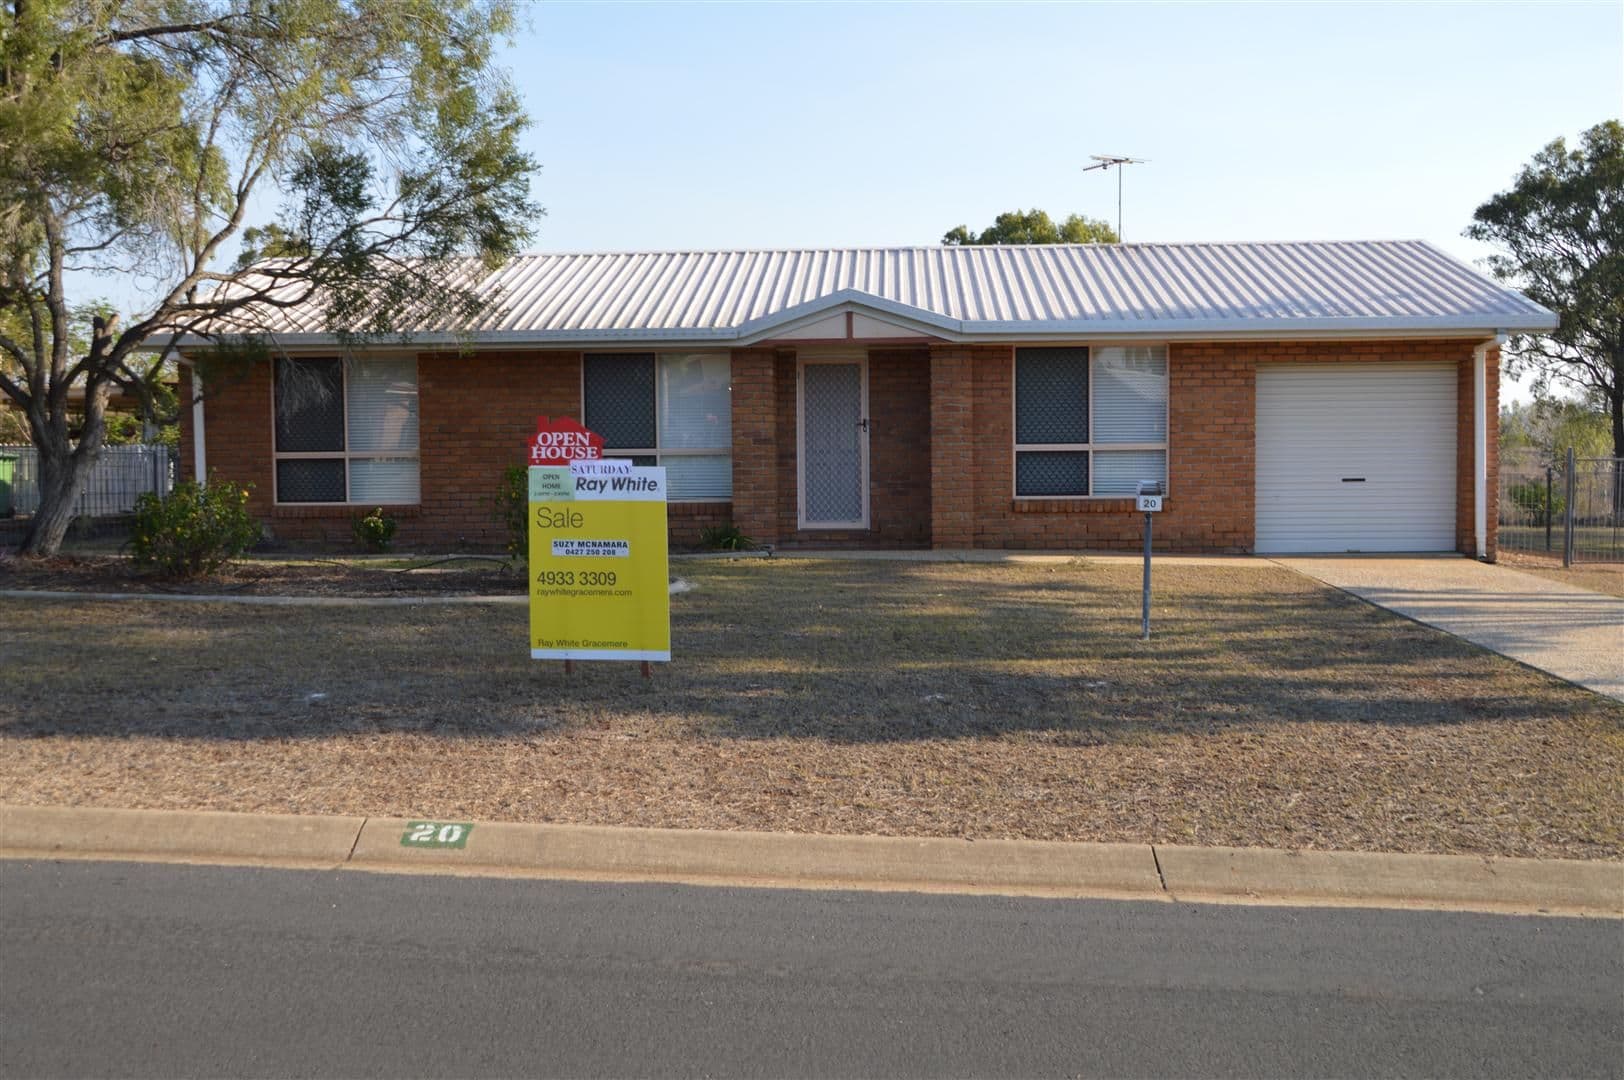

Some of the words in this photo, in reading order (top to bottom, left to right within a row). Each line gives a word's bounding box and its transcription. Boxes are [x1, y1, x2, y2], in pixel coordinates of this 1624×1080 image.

[537, 431, 591, 446] OPEN
[531, 446, 599, 459] HOUSE
[571, 464, 631, 475] SATURDAY
[575, 477, 608, 493] Ray
[611, 477, 658, 491] White
[1143, 499, 1157, 508] 20
[536, 506, 584, 529] Sale
[536, 571, 575, 586] 4933
[579, 571, 617, 586] 3309
[538, 639, 554, 648] Ray
[556, 639, 579, 647] White
[581, 639, 628, 648] Gracemere
[409, 824, 462, 842] 20
